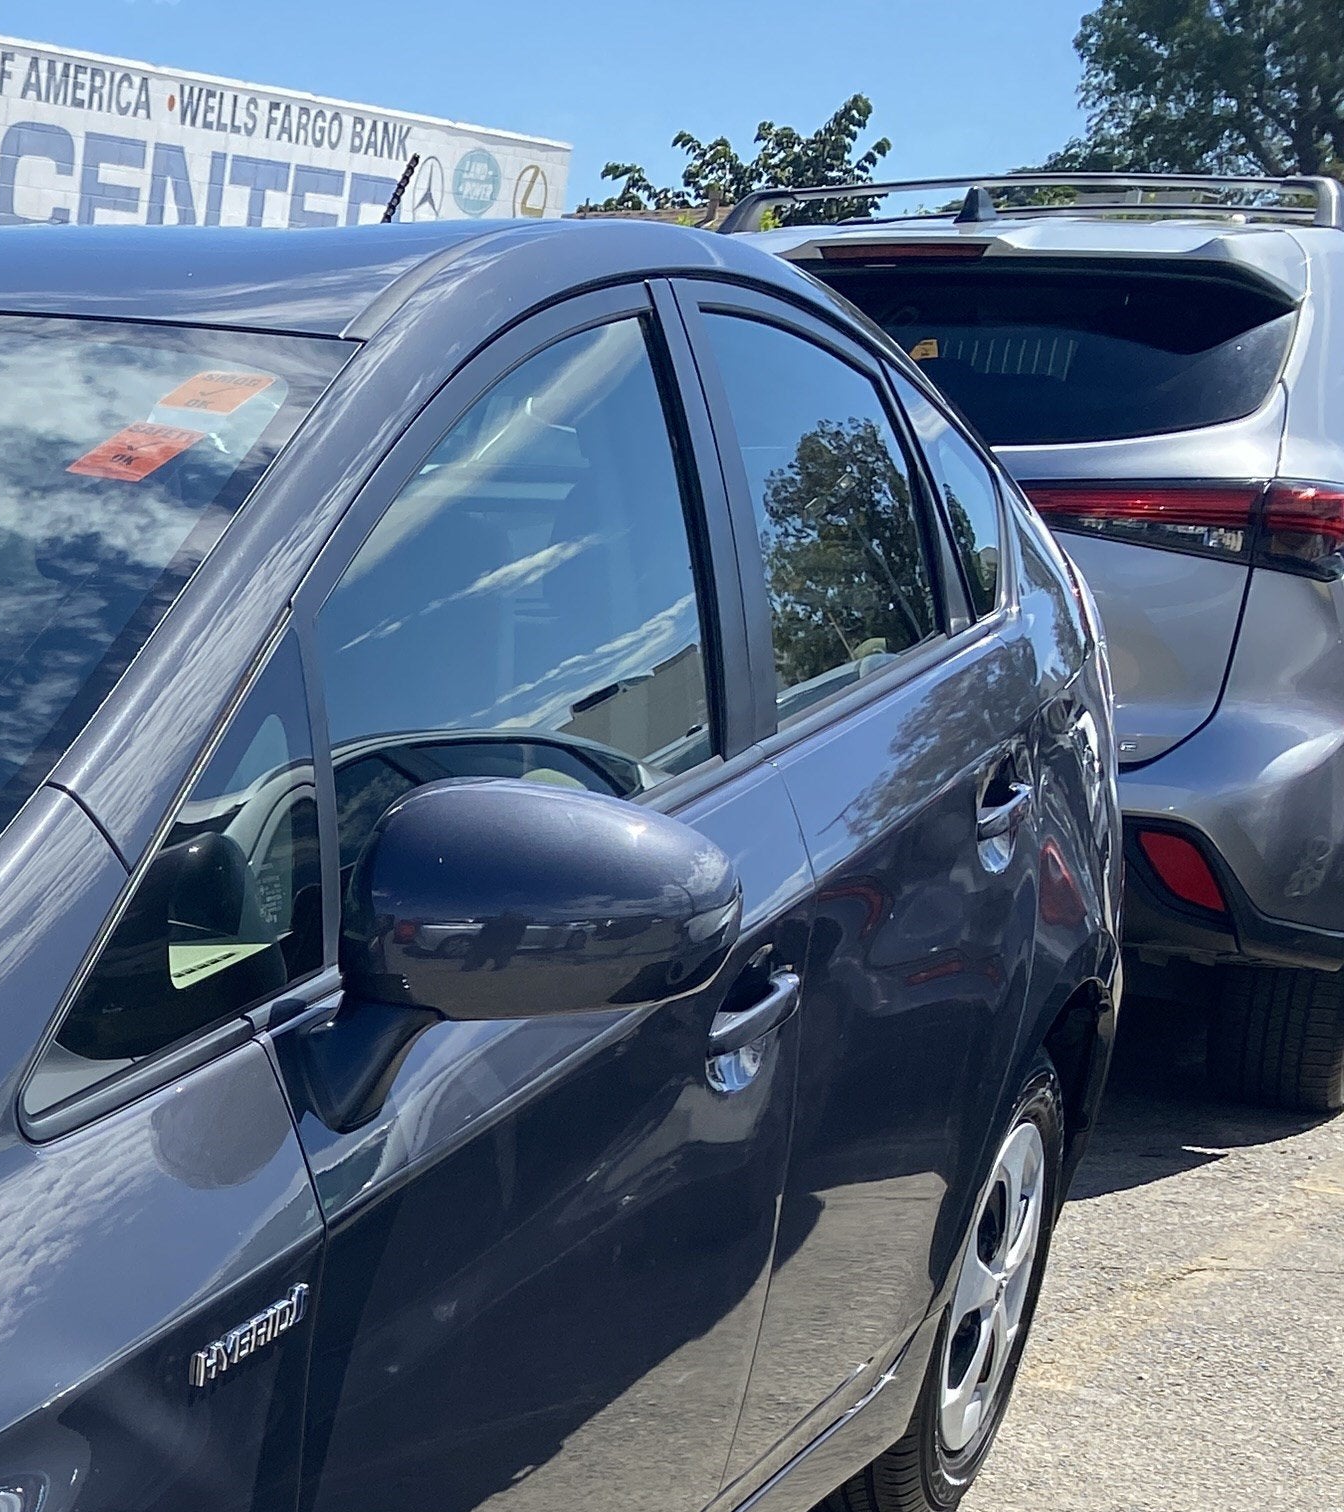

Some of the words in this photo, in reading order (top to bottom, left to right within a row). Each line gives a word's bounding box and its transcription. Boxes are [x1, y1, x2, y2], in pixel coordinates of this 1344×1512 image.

[21, 57, 152, 120] AMERICA
[179, 83, 258, 137] WELLS
[265, 101, 343, 151] FARGO
[349, 116, 413, 162] BANK
[203, 373, 261, 387] SMOG
[185, 399, 214, 410] OK
[111, 453, 137, 466] OK
[188, 1282, 310, 1388] HYBRID
